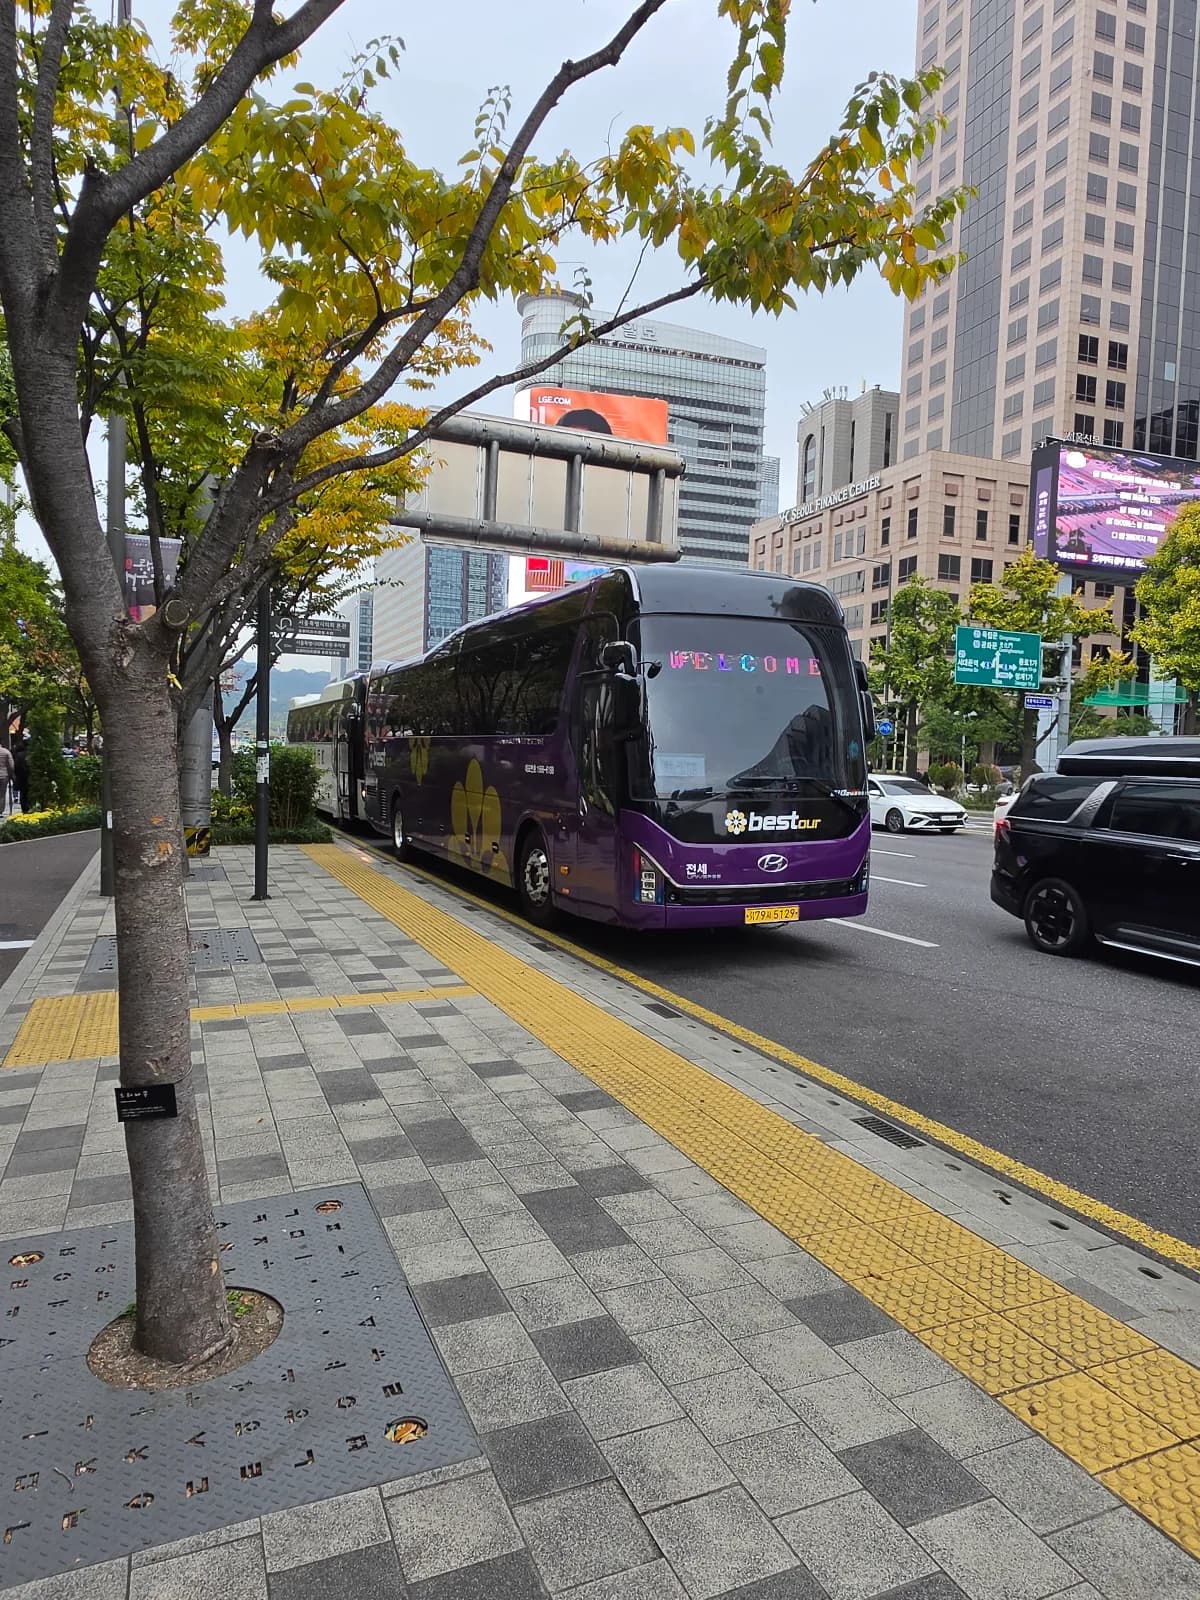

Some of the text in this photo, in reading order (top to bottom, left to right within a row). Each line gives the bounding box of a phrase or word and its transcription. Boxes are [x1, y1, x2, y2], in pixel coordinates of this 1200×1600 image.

[538, 396, 571, 406] LGE.COM
[791, 475, 880, 521] SEOUL FINANCE CENTER
[670, 650, 821, 676] WELCOME
[686, 863, 708, 875] 전세
